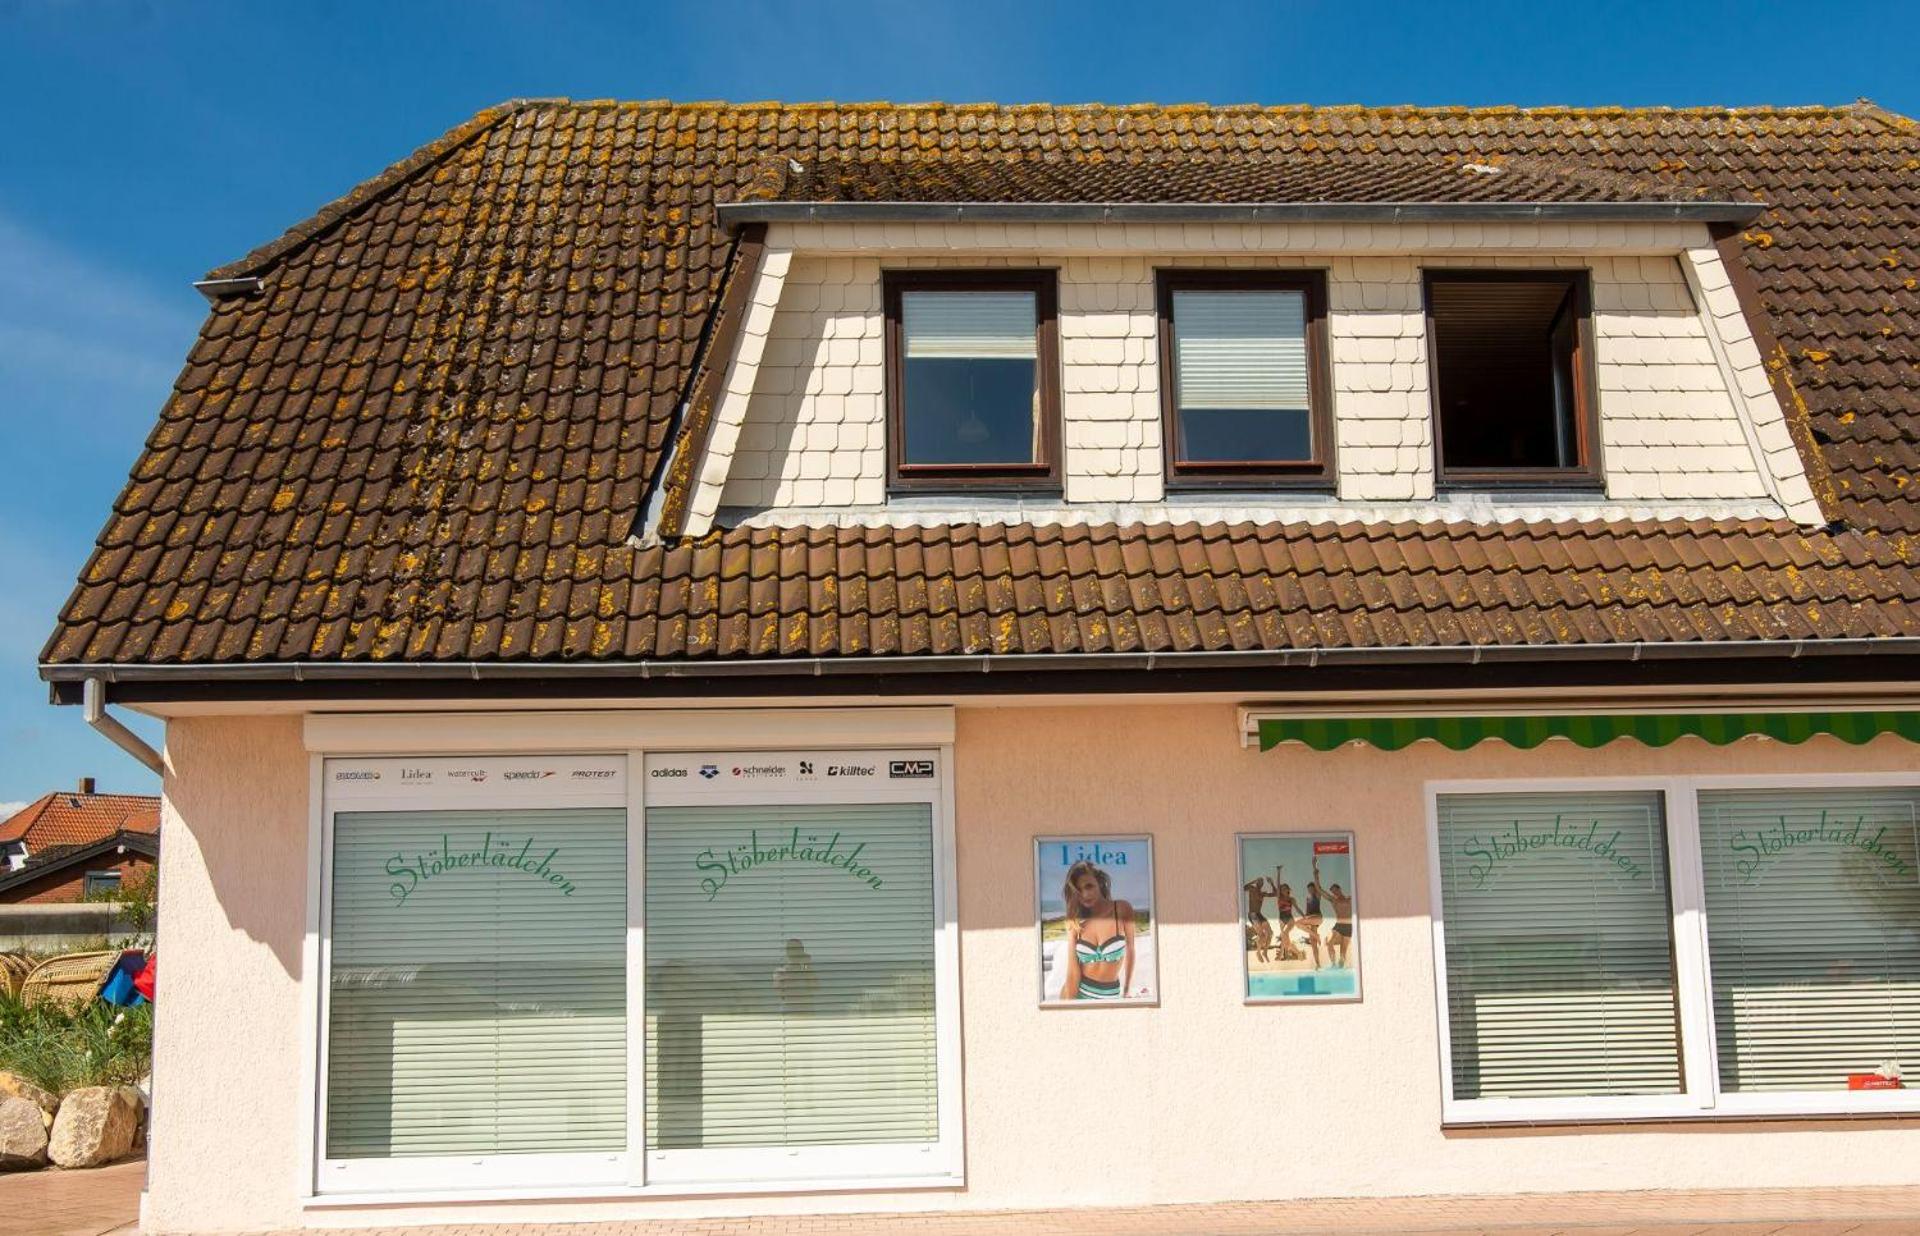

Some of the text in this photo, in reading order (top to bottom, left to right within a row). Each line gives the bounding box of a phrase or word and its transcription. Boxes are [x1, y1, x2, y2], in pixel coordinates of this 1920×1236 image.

[571, 770, 617, 778] PROTEST
[651, 768, 689, 778] adidas
[840, 765, 875, 776] killtec
[891, 762, 933, 774] CMP
[1062, 844, 1128, 866] Lidea
[1464, 815, 1642, 888] Stöberlädchen
[1730, 811, 1910, 882] Stöberlädchen
[386, 832, 577, 908] Stöberlädchen
[696, 827, 886, 902] Stöberlädchen
